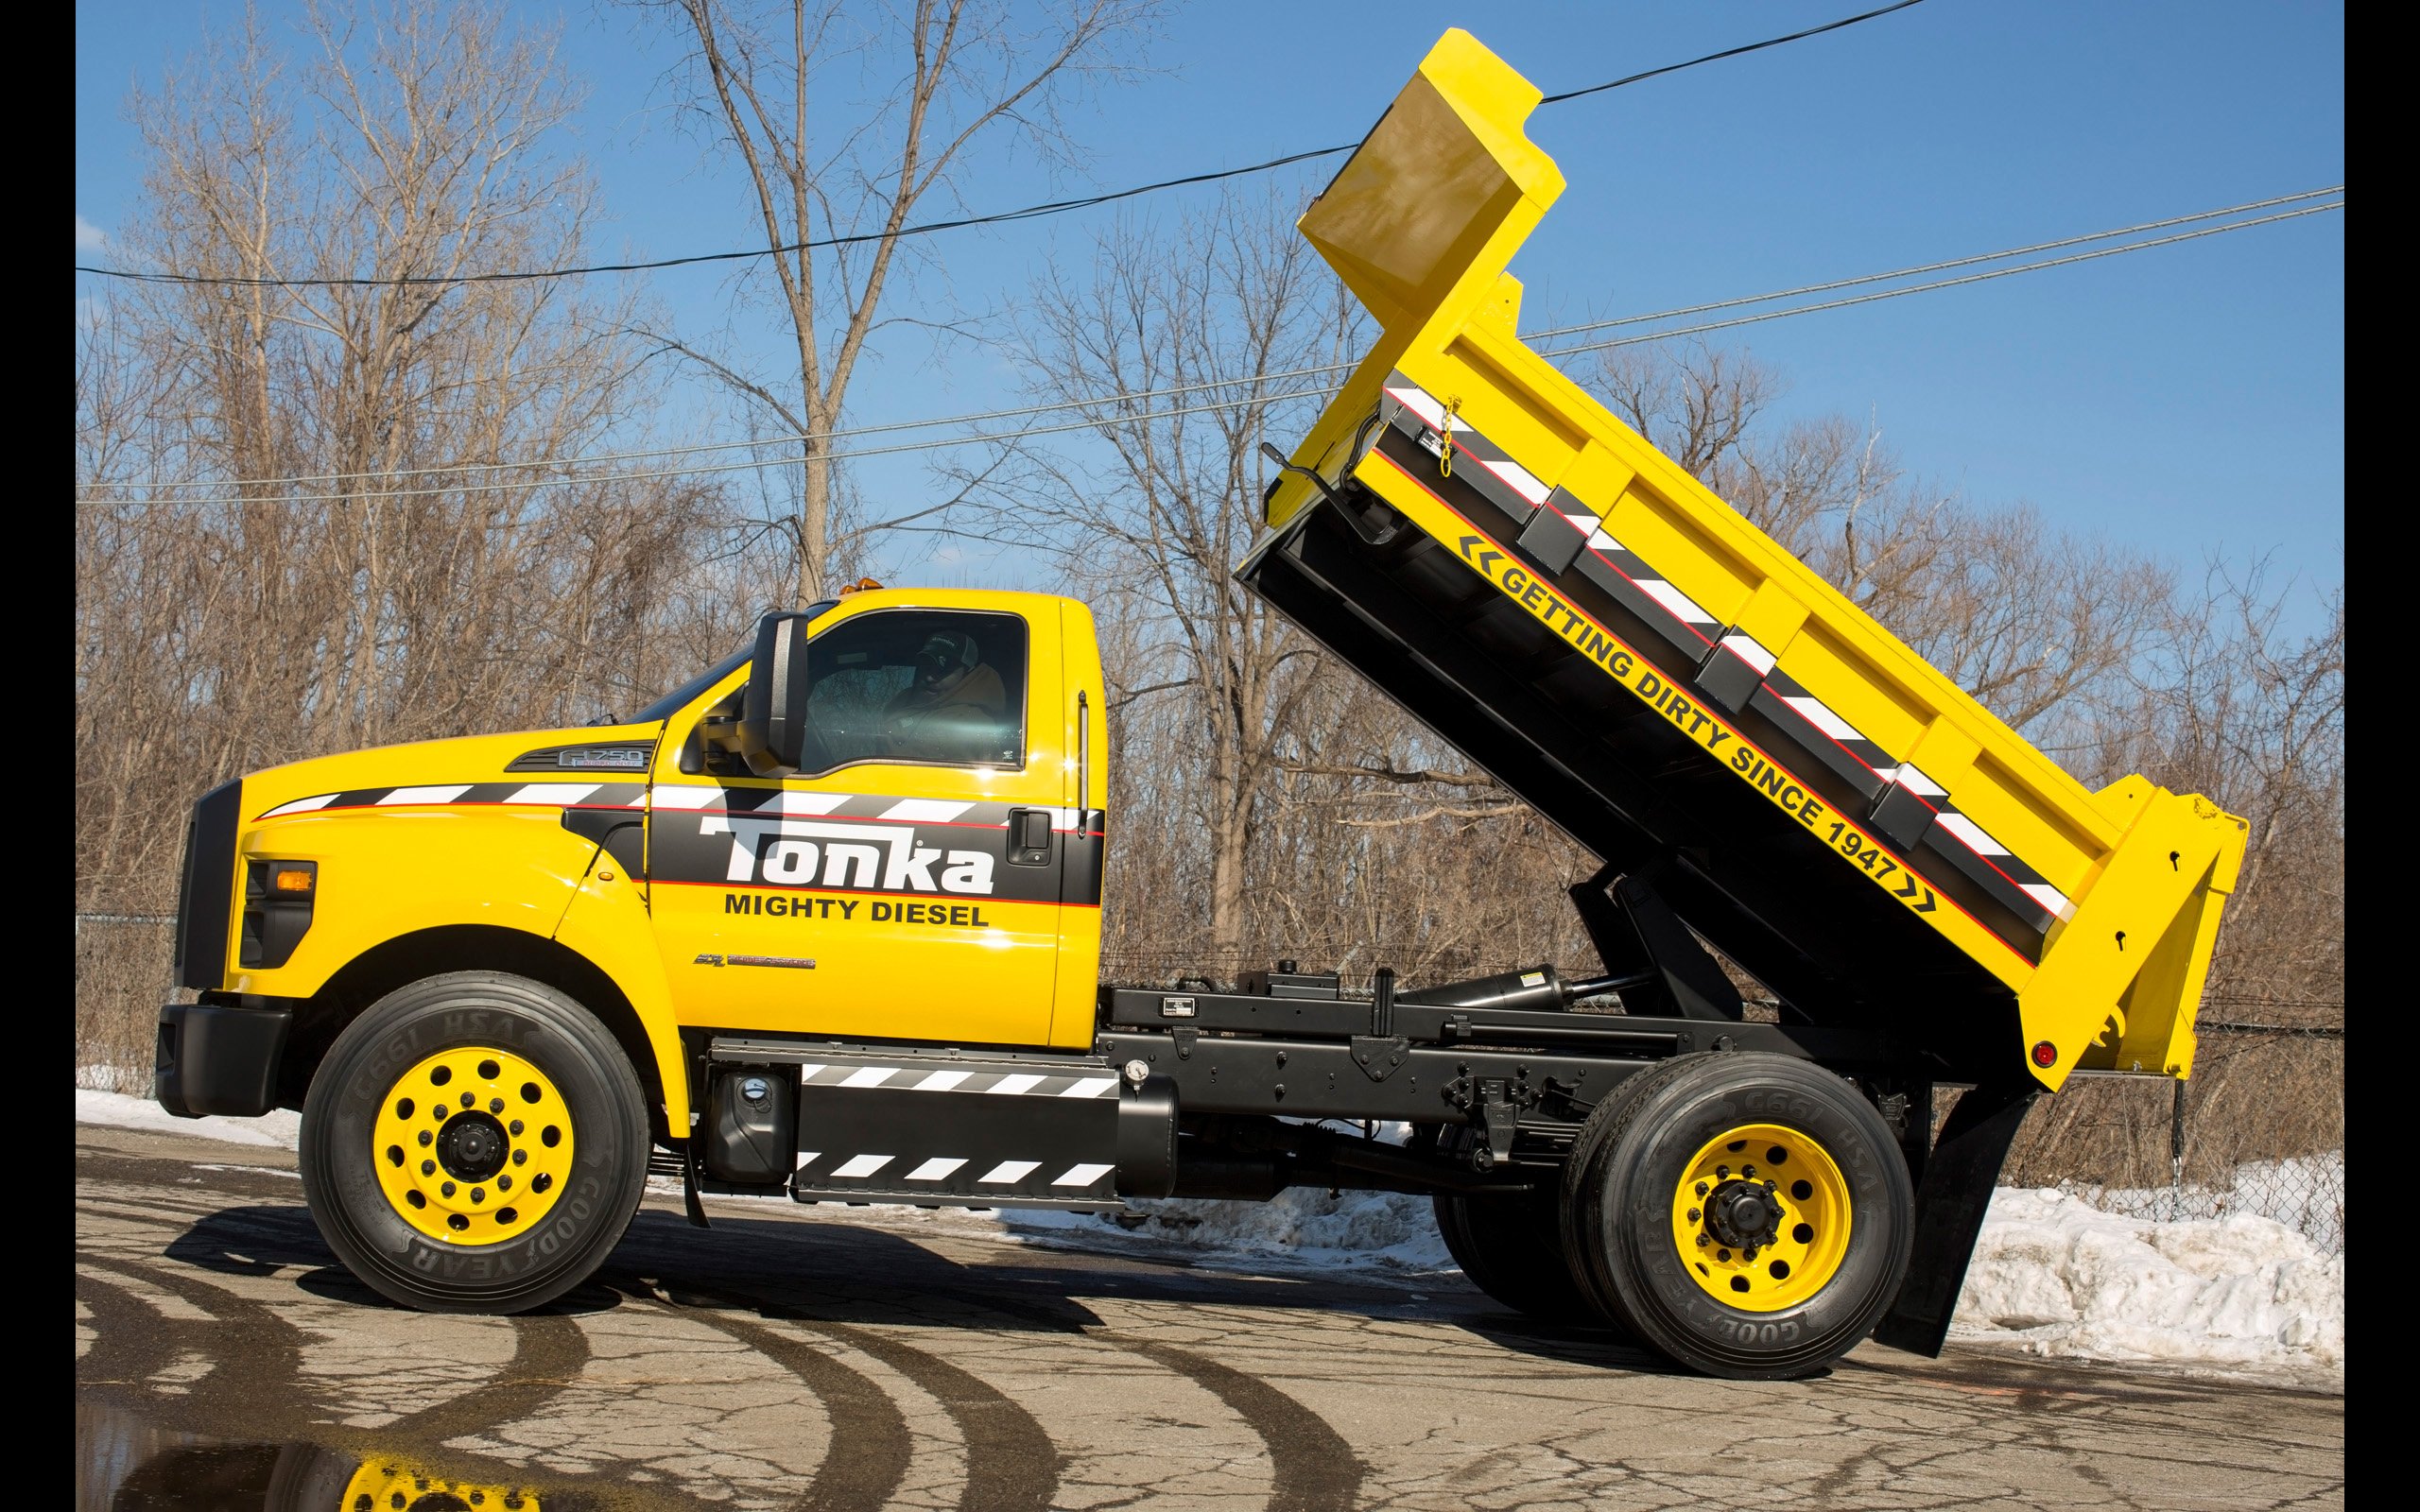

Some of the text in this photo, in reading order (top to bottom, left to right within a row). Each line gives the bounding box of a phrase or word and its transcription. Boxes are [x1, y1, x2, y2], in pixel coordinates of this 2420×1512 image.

[1501, 567, 1898, 880] GETTING DIRTY SINCE 1947
[700, 815, 995, 895] Tonka
[725, 894, 990, 928] MIGHTY DIESEL
